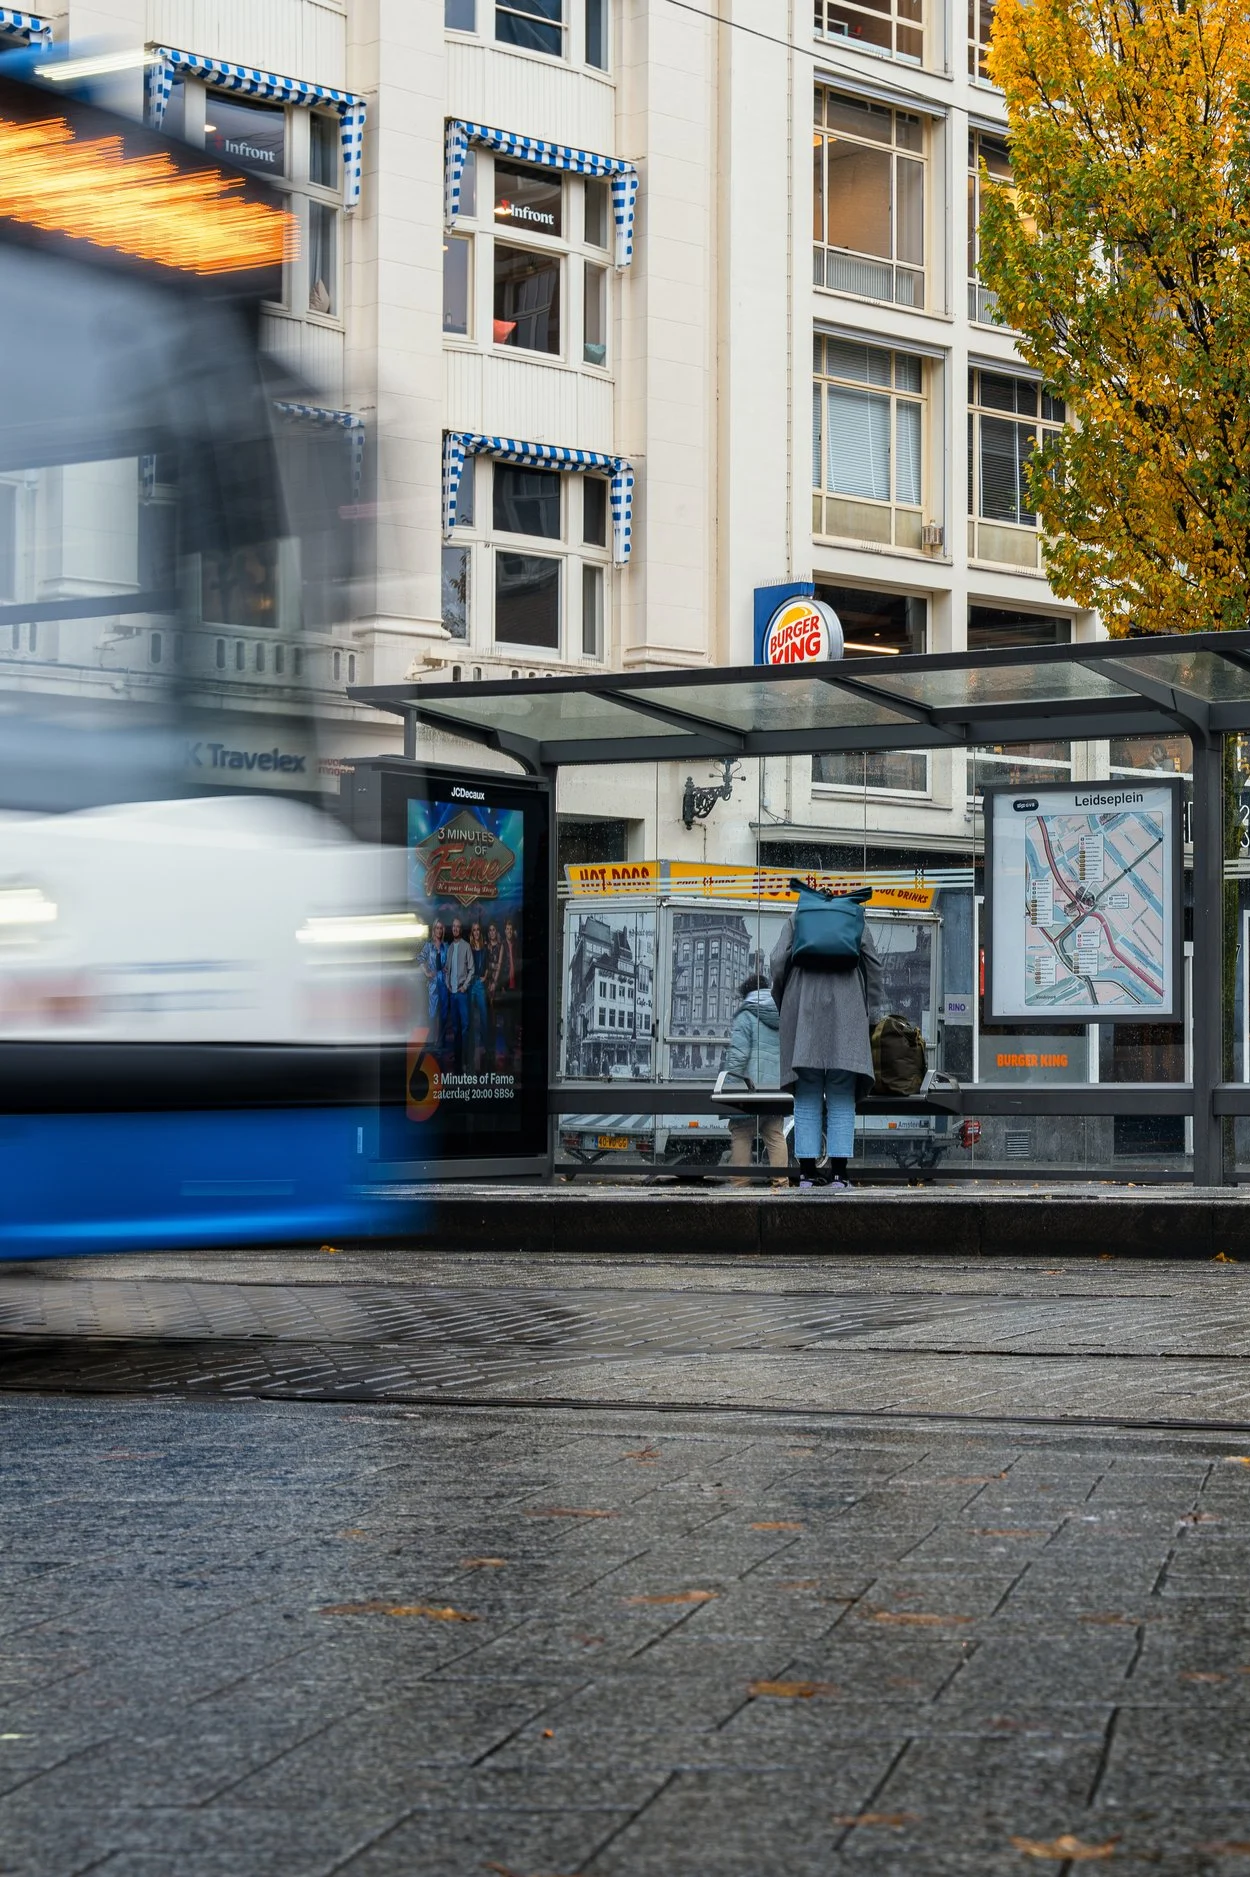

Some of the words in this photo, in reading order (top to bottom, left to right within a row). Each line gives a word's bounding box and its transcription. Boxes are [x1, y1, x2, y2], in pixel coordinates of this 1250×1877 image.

[225, 139, 276, 163] Infront
[511, 204, 554, 226] Infront
[770, 616, 820, 655] BURGER
[772, 632, 821, 664] KING
[206, 743, 307, 773] Travelex
[451, 787, 485, 800] JCDecaux
[1074, 792, 1144, 807] Leidseplein
[438, 827, 445, 840] 3
[447, 829, 495, 843] MINUTES
[474, 845, 488, 856] OF
[425, 842, 502, 897] Fame
[897, 888, 929, 904] DRINKS
[948, 1003, 966, 1012] RINO
[996, 1053, 1038, 1068] BURGER
[1040, 1053, 1069, 1068] KING
[433, 1074, 439, 1085] 3
[441, 1072, 478, 1085] Minutes
[479, 1072, 489, 1085] of
[490, 1073, 515, 1085] Fame
[433, 1086, 471, 1101] zaterdag
[471, 1088, 493, 1099] 20:00
[493, 1088, 515, 1099] SBS6
